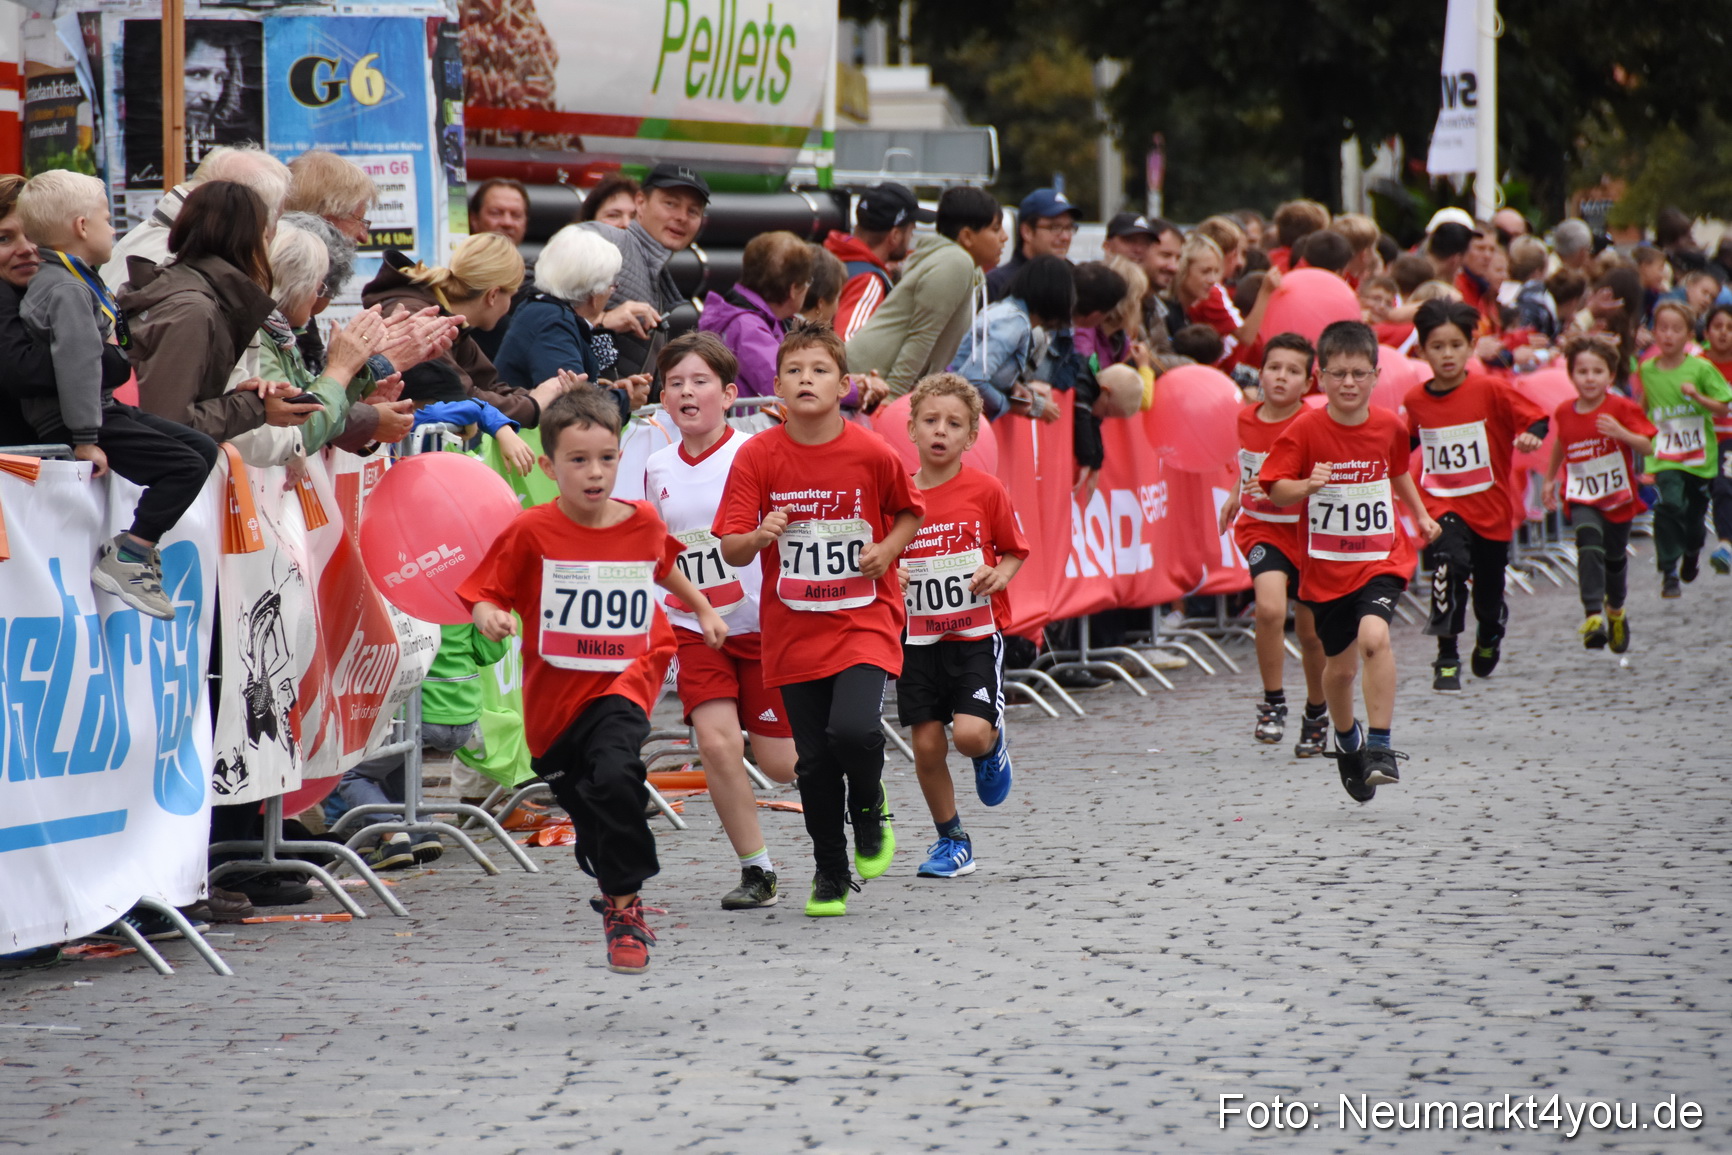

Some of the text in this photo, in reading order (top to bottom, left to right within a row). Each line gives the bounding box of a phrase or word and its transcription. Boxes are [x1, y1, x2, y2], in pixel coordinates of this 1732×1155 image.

[652, 0, 797, 104] Pellets
[286, 52, 386, 108] G6
[389, 161, 409, 175] G6
[377, 200, 404, 211] amilie
[375, 232, 391, 246] 14
[1663, 427, 1702, 450] 7404
[1426, 440, 1480, 470] 7431
[1575, 468, 1623, 496] 7075
[769, 488, 833, 501] Neumarkter
[1317, 500, 1388, 532] 7196
[1340, 540, 1366, 550] Paul
[425, 553, 466, 579] energie
[676, 547, 726, 585] 071
[933, 553, 978, 570] BOCK
[553, 572, 611, 581] NeuerMarkt
[597, 565, 649, 580] BOCK
[805, 584, 847, 599] Adrian
[555, 588, 648, 629] 7090
[925, 616, 973, 633] Mariano
[577, 639, 625, 656] Niklas
